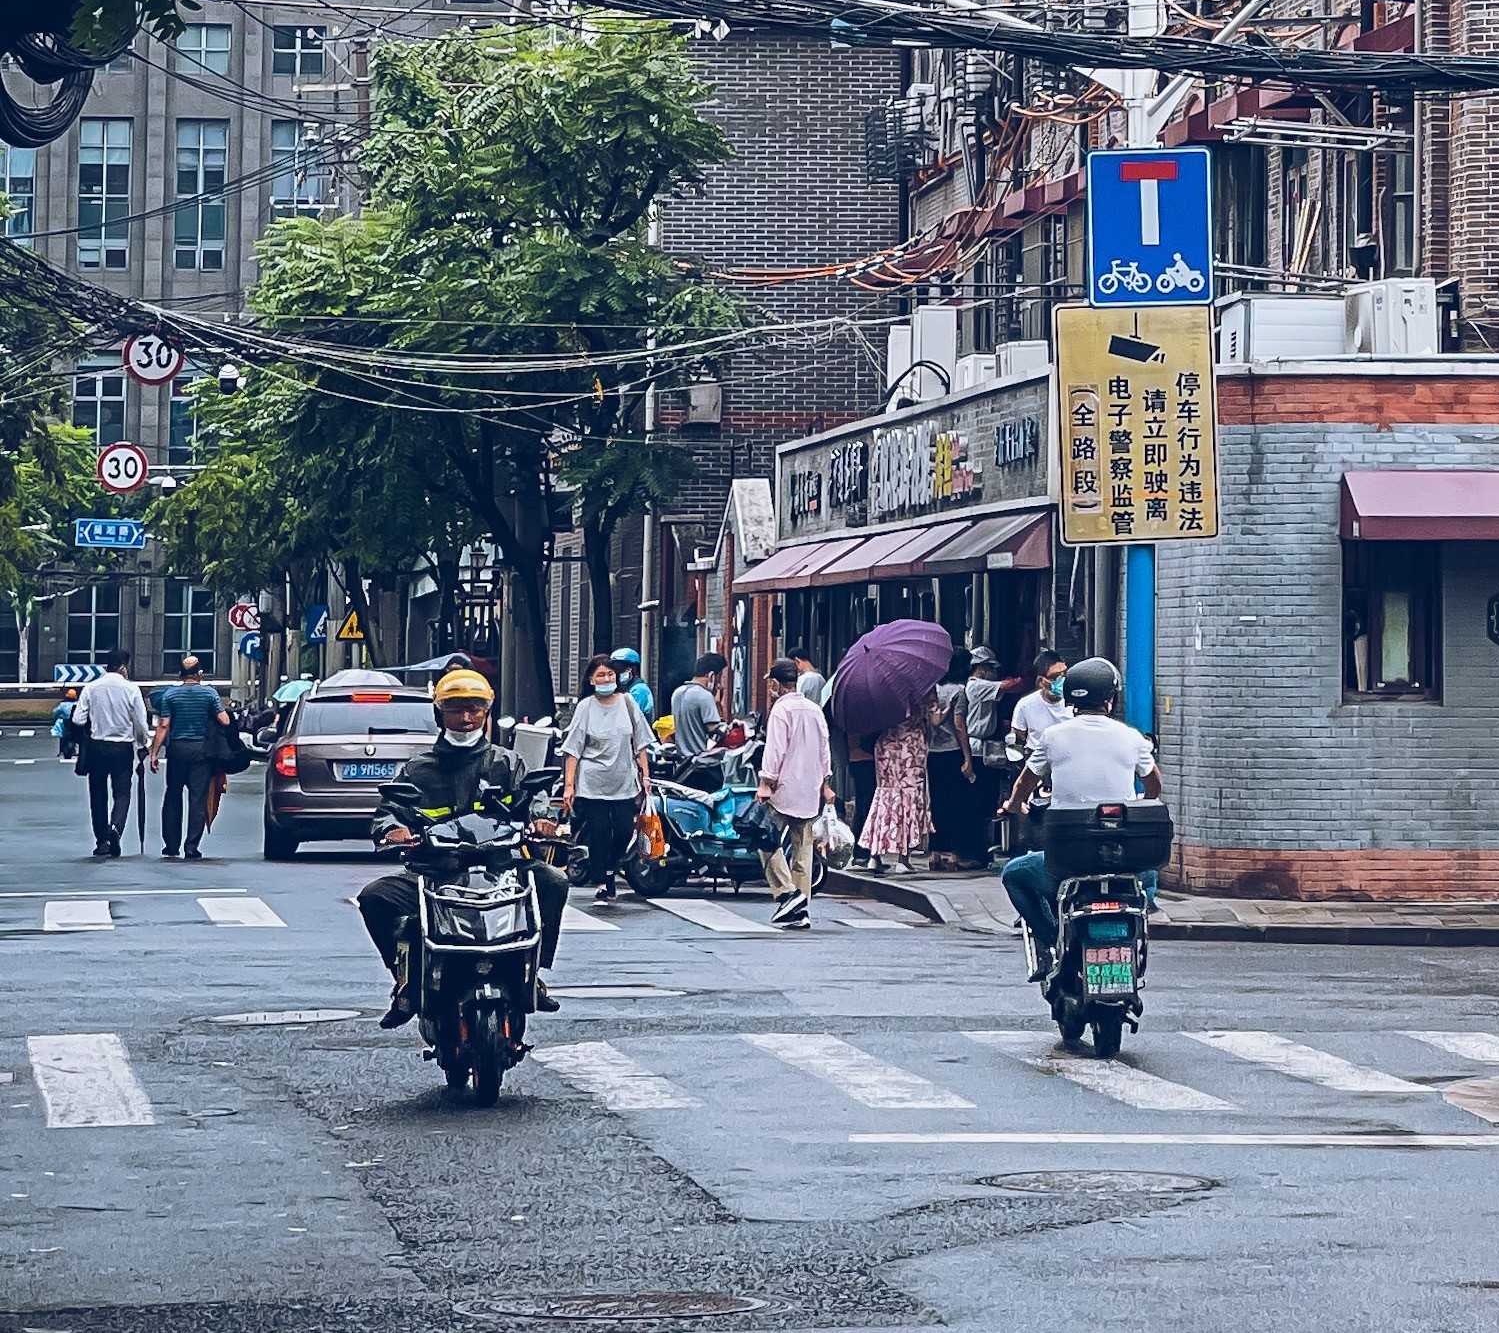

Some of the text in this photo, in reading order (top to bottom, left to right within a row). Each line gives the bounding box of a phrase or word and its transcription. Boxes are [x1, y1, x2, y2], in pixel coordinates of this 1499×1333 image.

[136, 341, 173, 369] 30
[108, 456, 138, 479] 30
[1108, 376, 1135, 535] 电子警察监管
[1143, 389, 1168, 521] 请立即驶离
[1176, 372, 1203, 531] 停车行为违法
